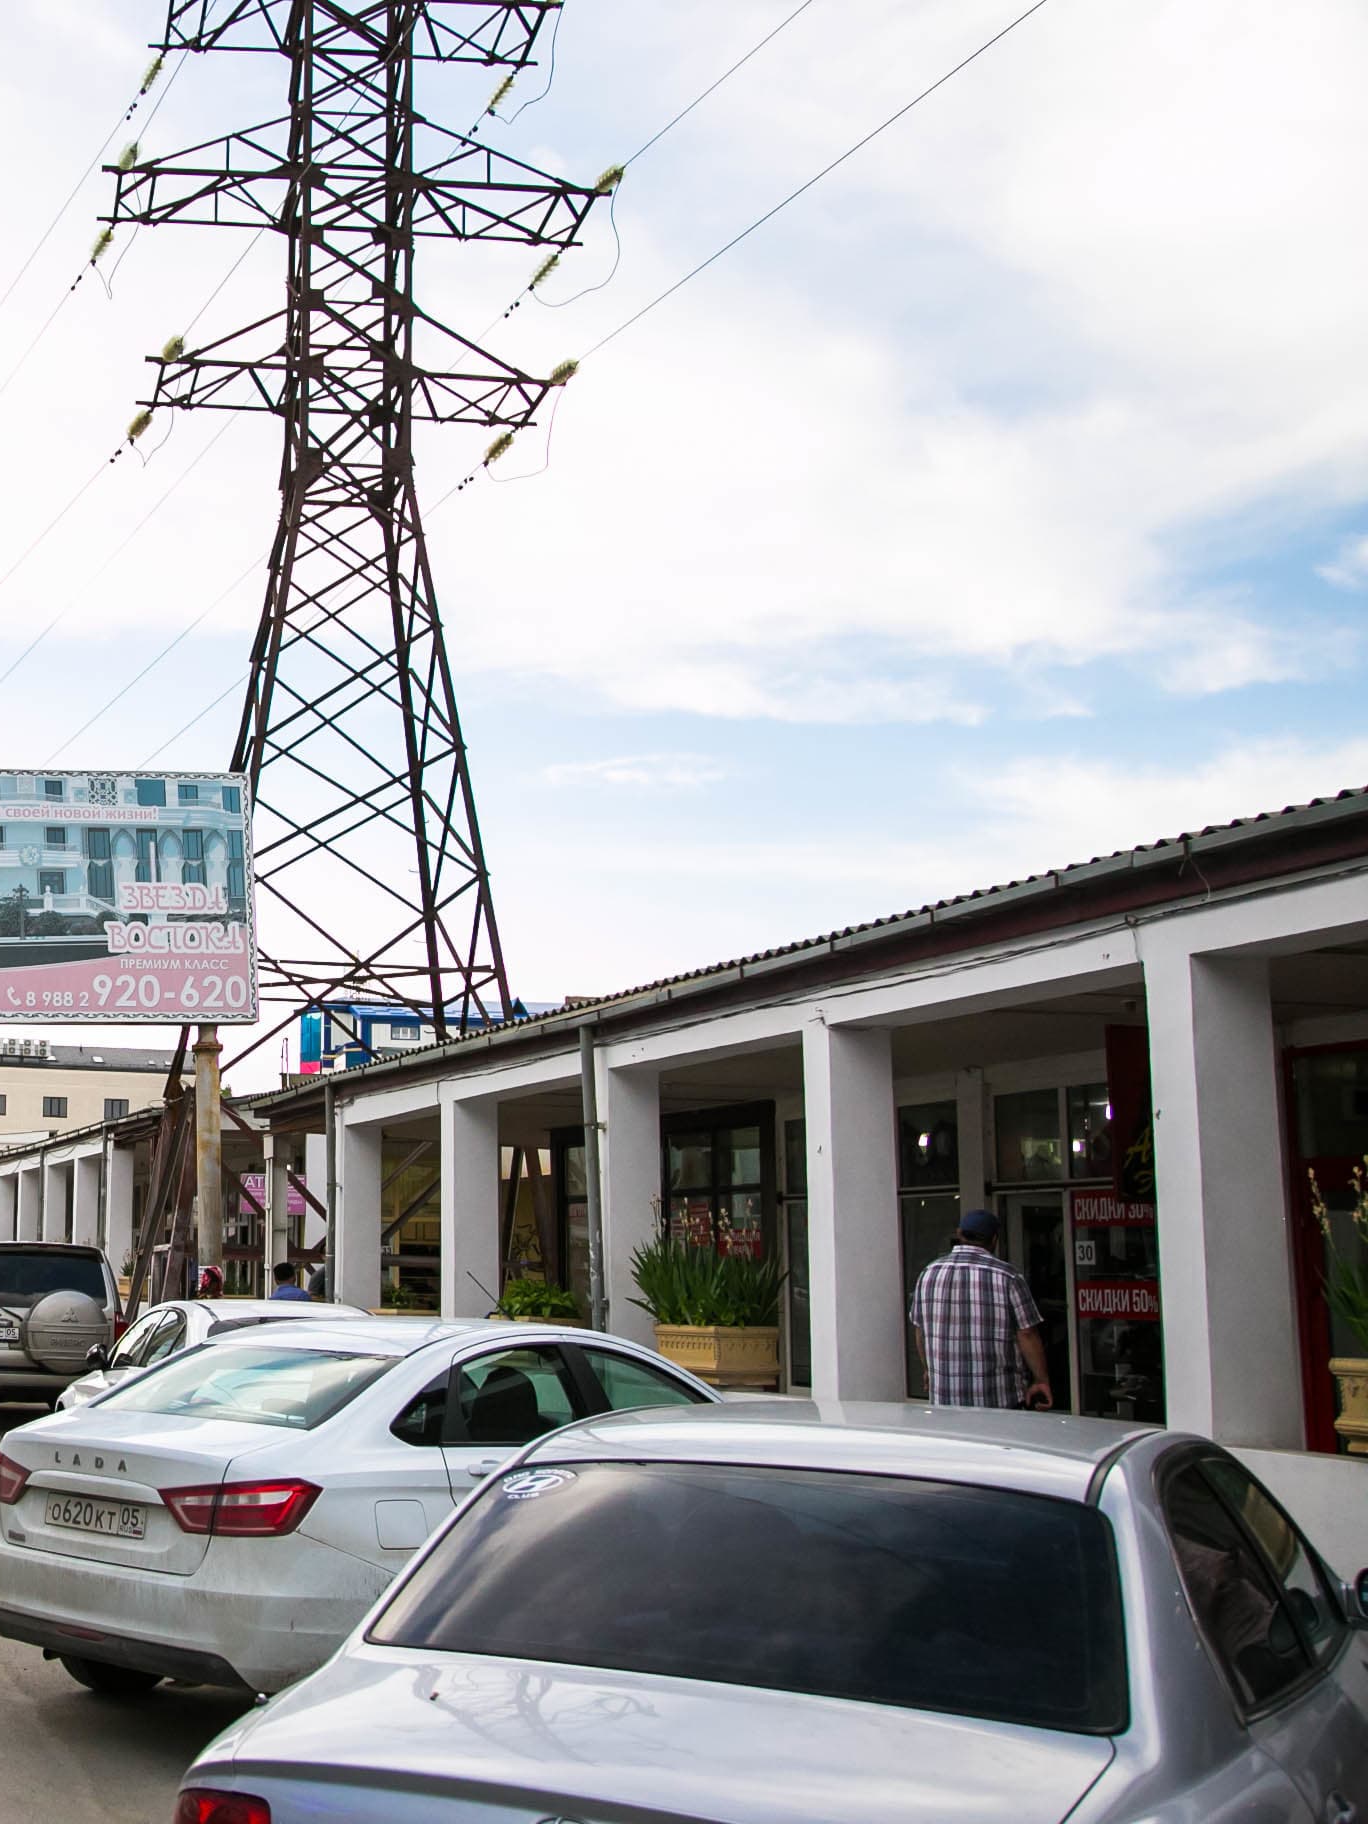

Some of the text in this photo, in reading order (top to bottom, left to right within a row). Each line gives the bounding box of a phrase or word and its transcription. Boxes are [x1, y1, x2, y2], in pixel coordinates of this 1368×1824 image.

[6, 805, 50, 819] своей
[54, 807, 101, 819] новой
[105, 808, 158, 820] жизни!
[107, 923, 242, 951] ВОСТОКА
[120, 959, 230, 970] ПРЕМИУМ КЛАСС
[25, 974, 248, 1009] 8 988 2 920-620
[1074, 1198, 1126, 1221] СКИДКИ
[1077, 1244, 1094, 1261] 30
[1078, 1288, 1158, 1315] СКИДКИ 50%
[6, 1328, 16, 1336] 05
[54, 1451, 127, 1473] LADA
[51, 1500, 140, 1530] О620КТ 05
